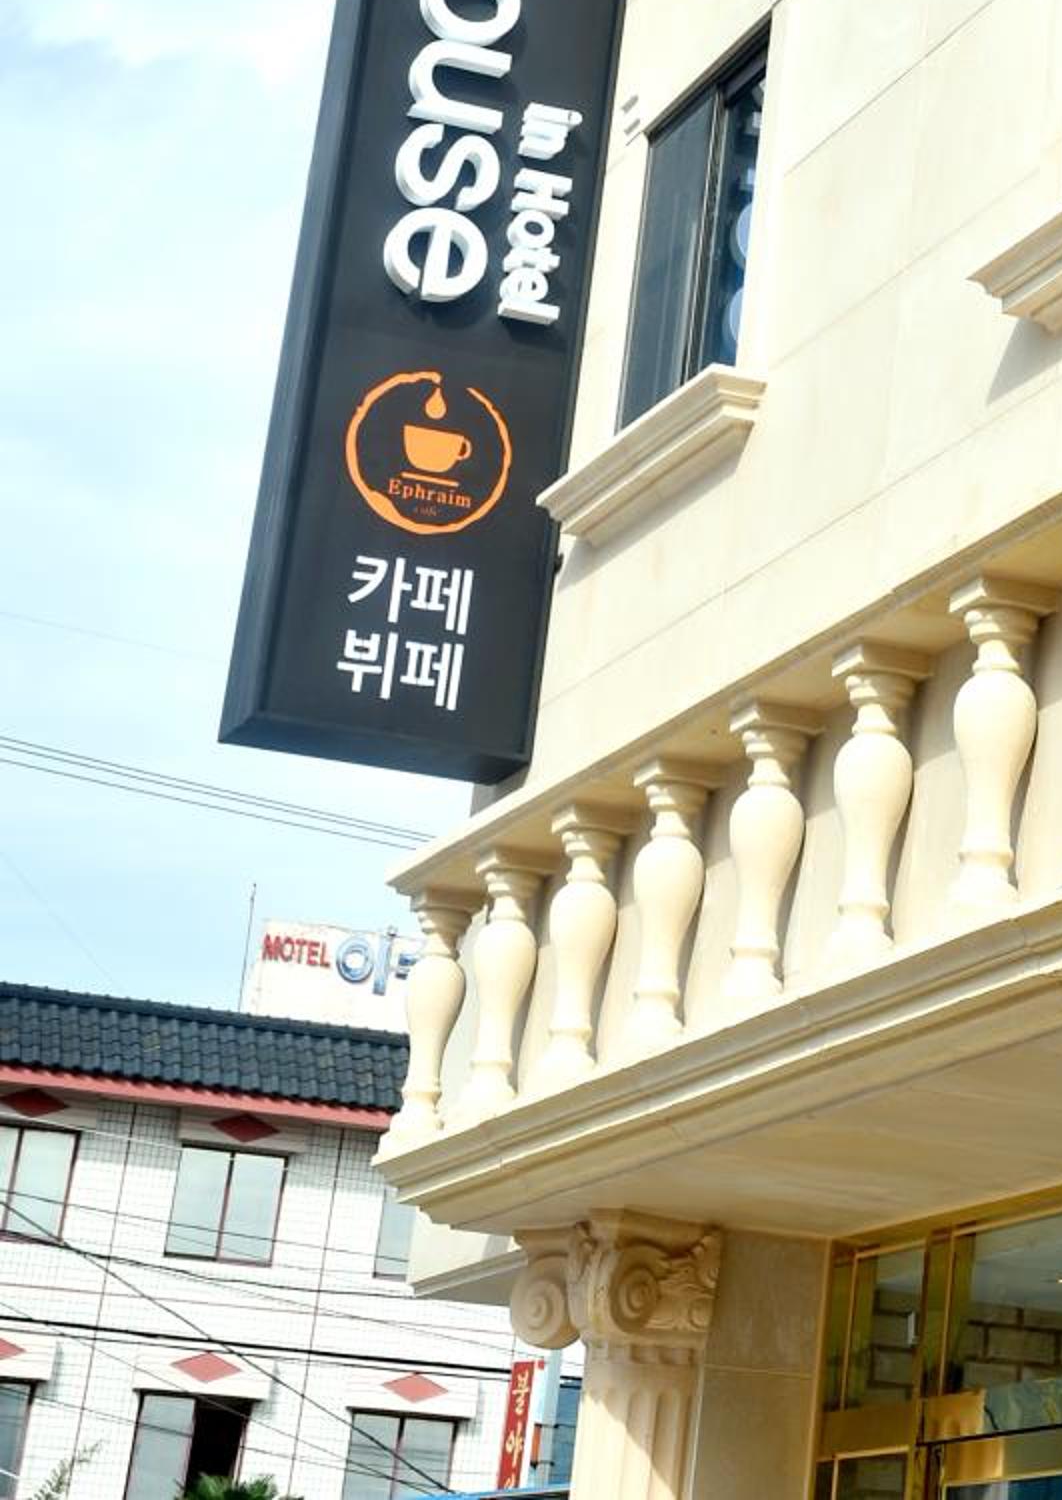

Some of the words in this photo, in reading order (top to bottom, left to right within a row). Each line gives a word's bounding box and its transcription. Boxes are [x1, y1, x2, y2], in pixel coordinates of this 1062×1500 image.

[518, 101, 583, 160] in
[498, 168, 573, 325] Hotel
[388, 478, 472, 509] Ephraim
[347, 555, 474, 636] 카페
[336, 629, 465, 711] 뷔페
[262, 934, 331, 968] MOTEL
